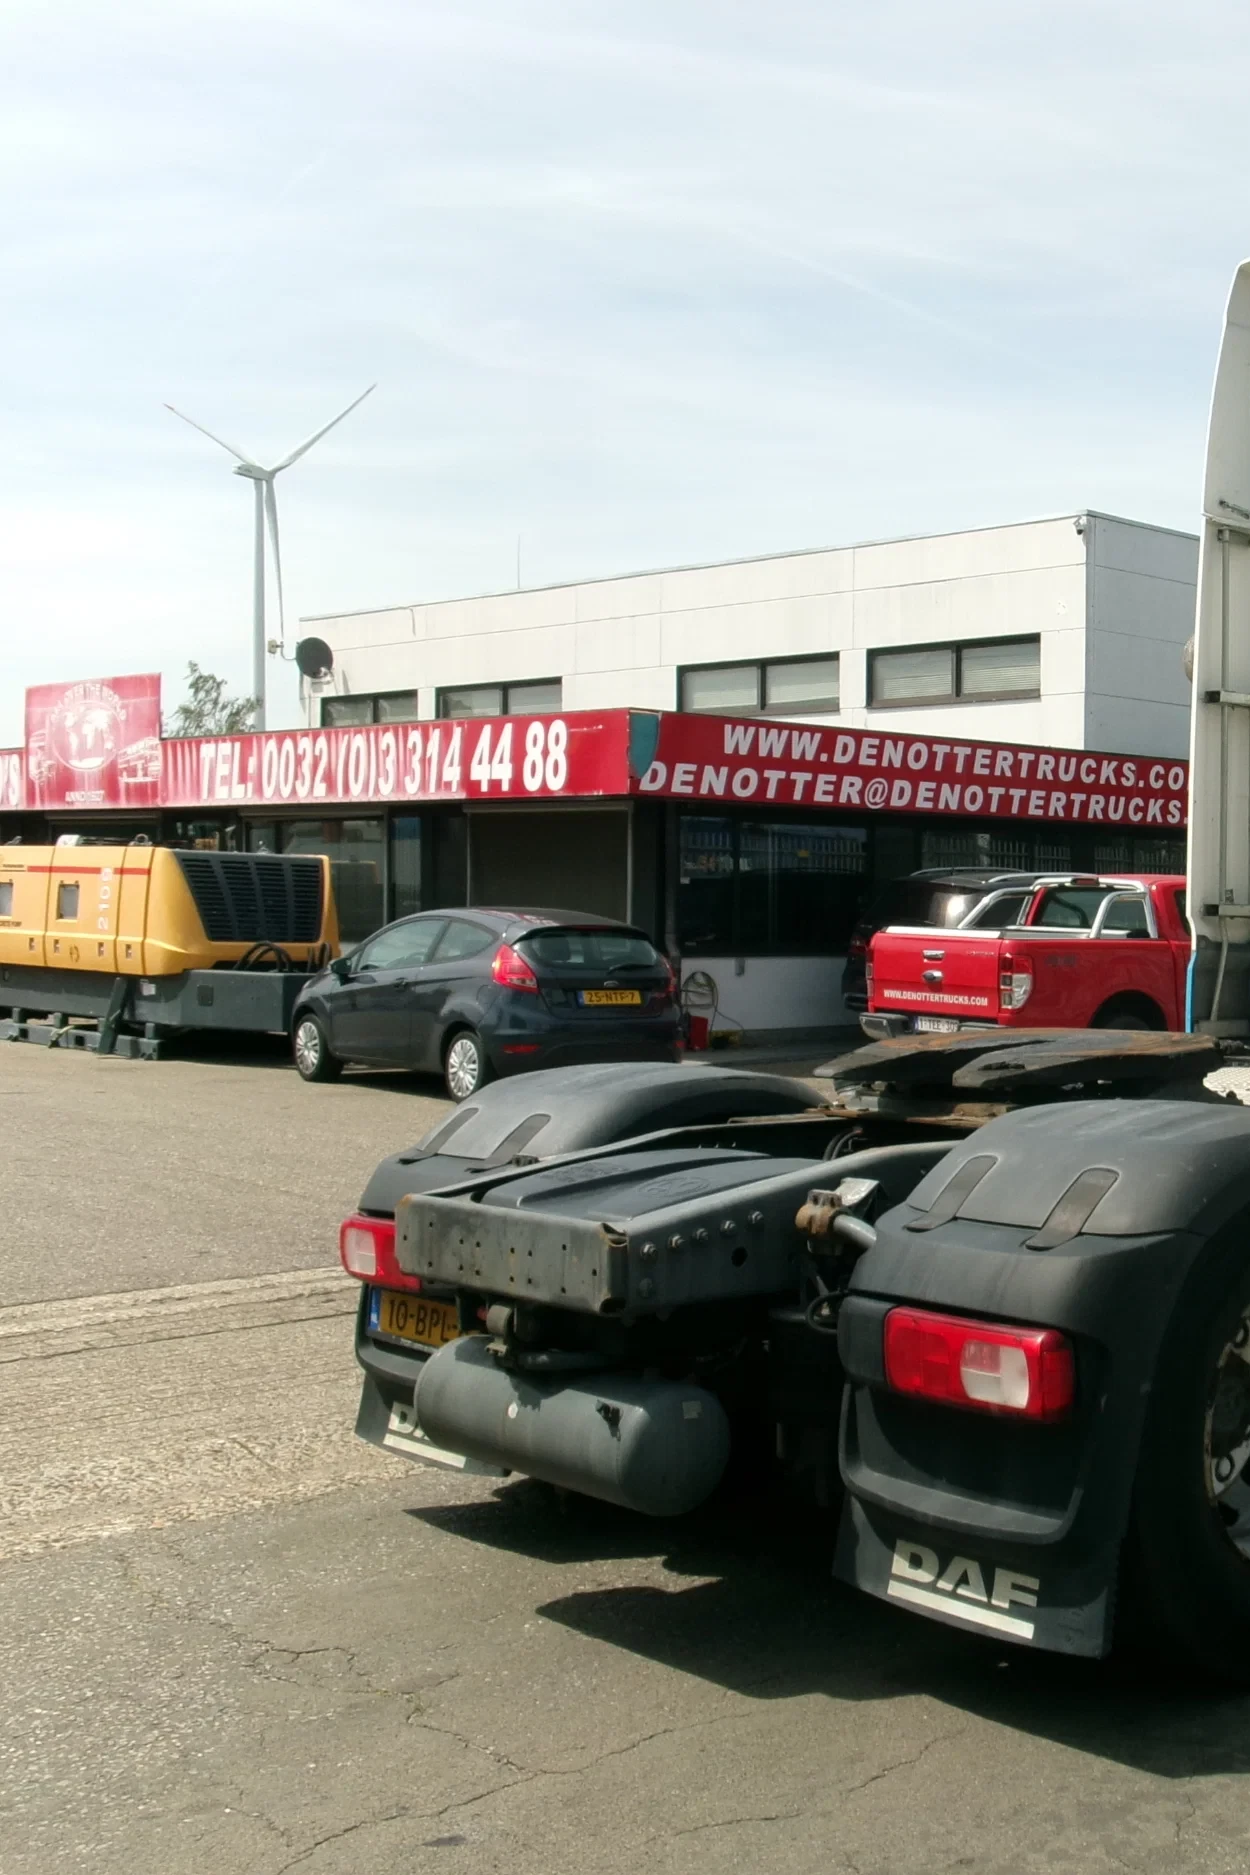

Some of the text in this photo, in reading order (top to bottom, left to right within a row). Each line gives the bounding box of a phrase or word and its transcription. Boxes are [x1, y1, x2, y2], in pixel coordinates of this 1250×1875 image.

[200, 741, 257, 799] TEL:
[262, 735, 329, 799] 0032
[404, 726, 462, 795] 314
[470, 722, 513, 792] 44
[523, 719, 567, 791] 88
[723, 724, 1187, 790] WWW.DENOTTERTRUCKS.CO
[883, 989, 988, 1006] WWW.DENOTTERTRUCKS.COM
[891, 1539, 1040, 1609] DAF
